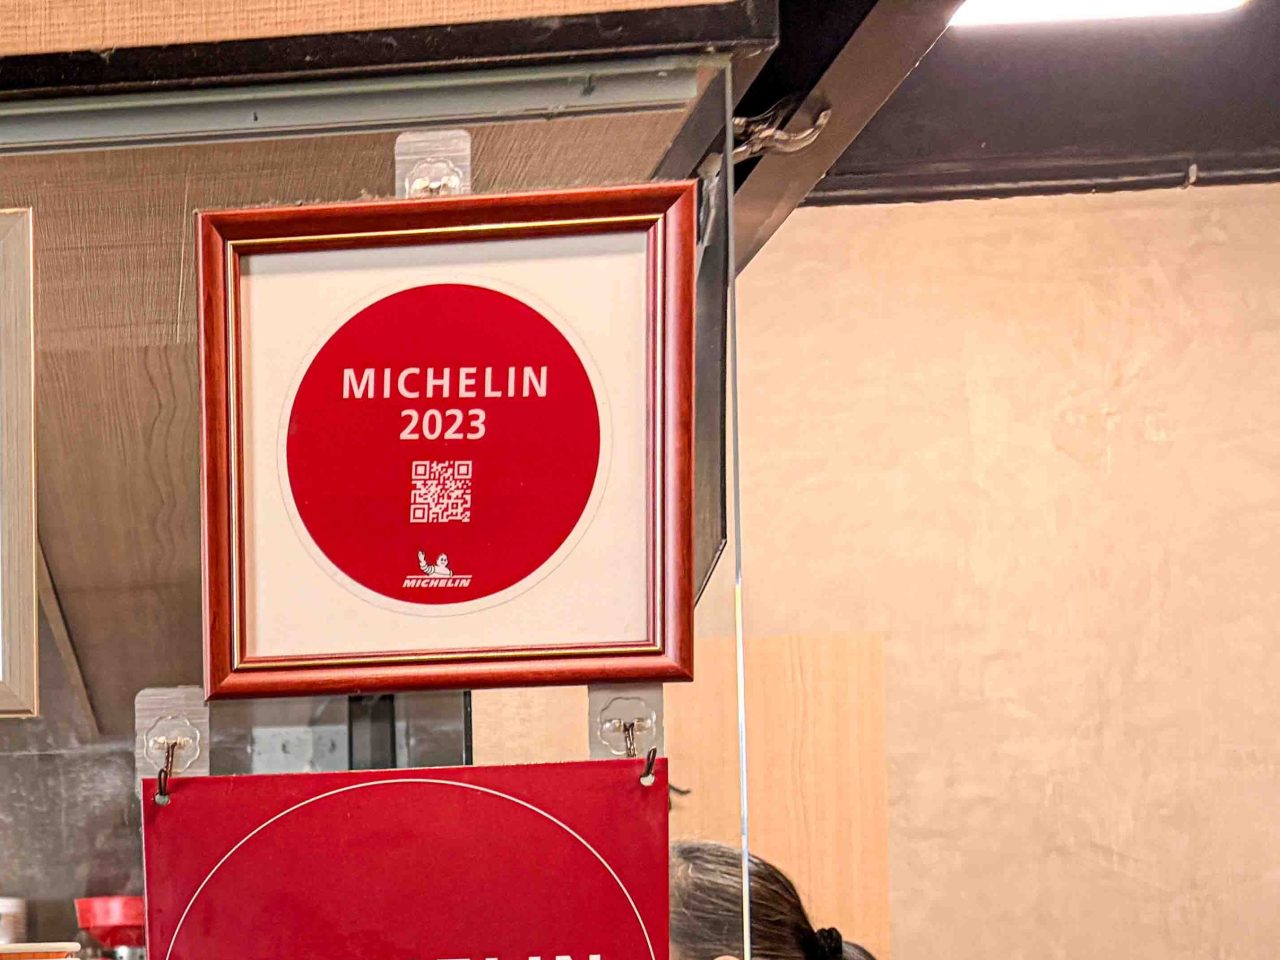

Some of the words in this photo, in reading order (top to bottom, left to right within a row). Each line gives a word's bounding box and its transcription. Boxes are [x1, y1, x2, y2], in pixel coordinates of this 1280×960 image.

[342, 366, 548, 399] MICHELIN
[399, 408, 487, 440] 2023
[402, 578, 472, 588] MICHELIN
